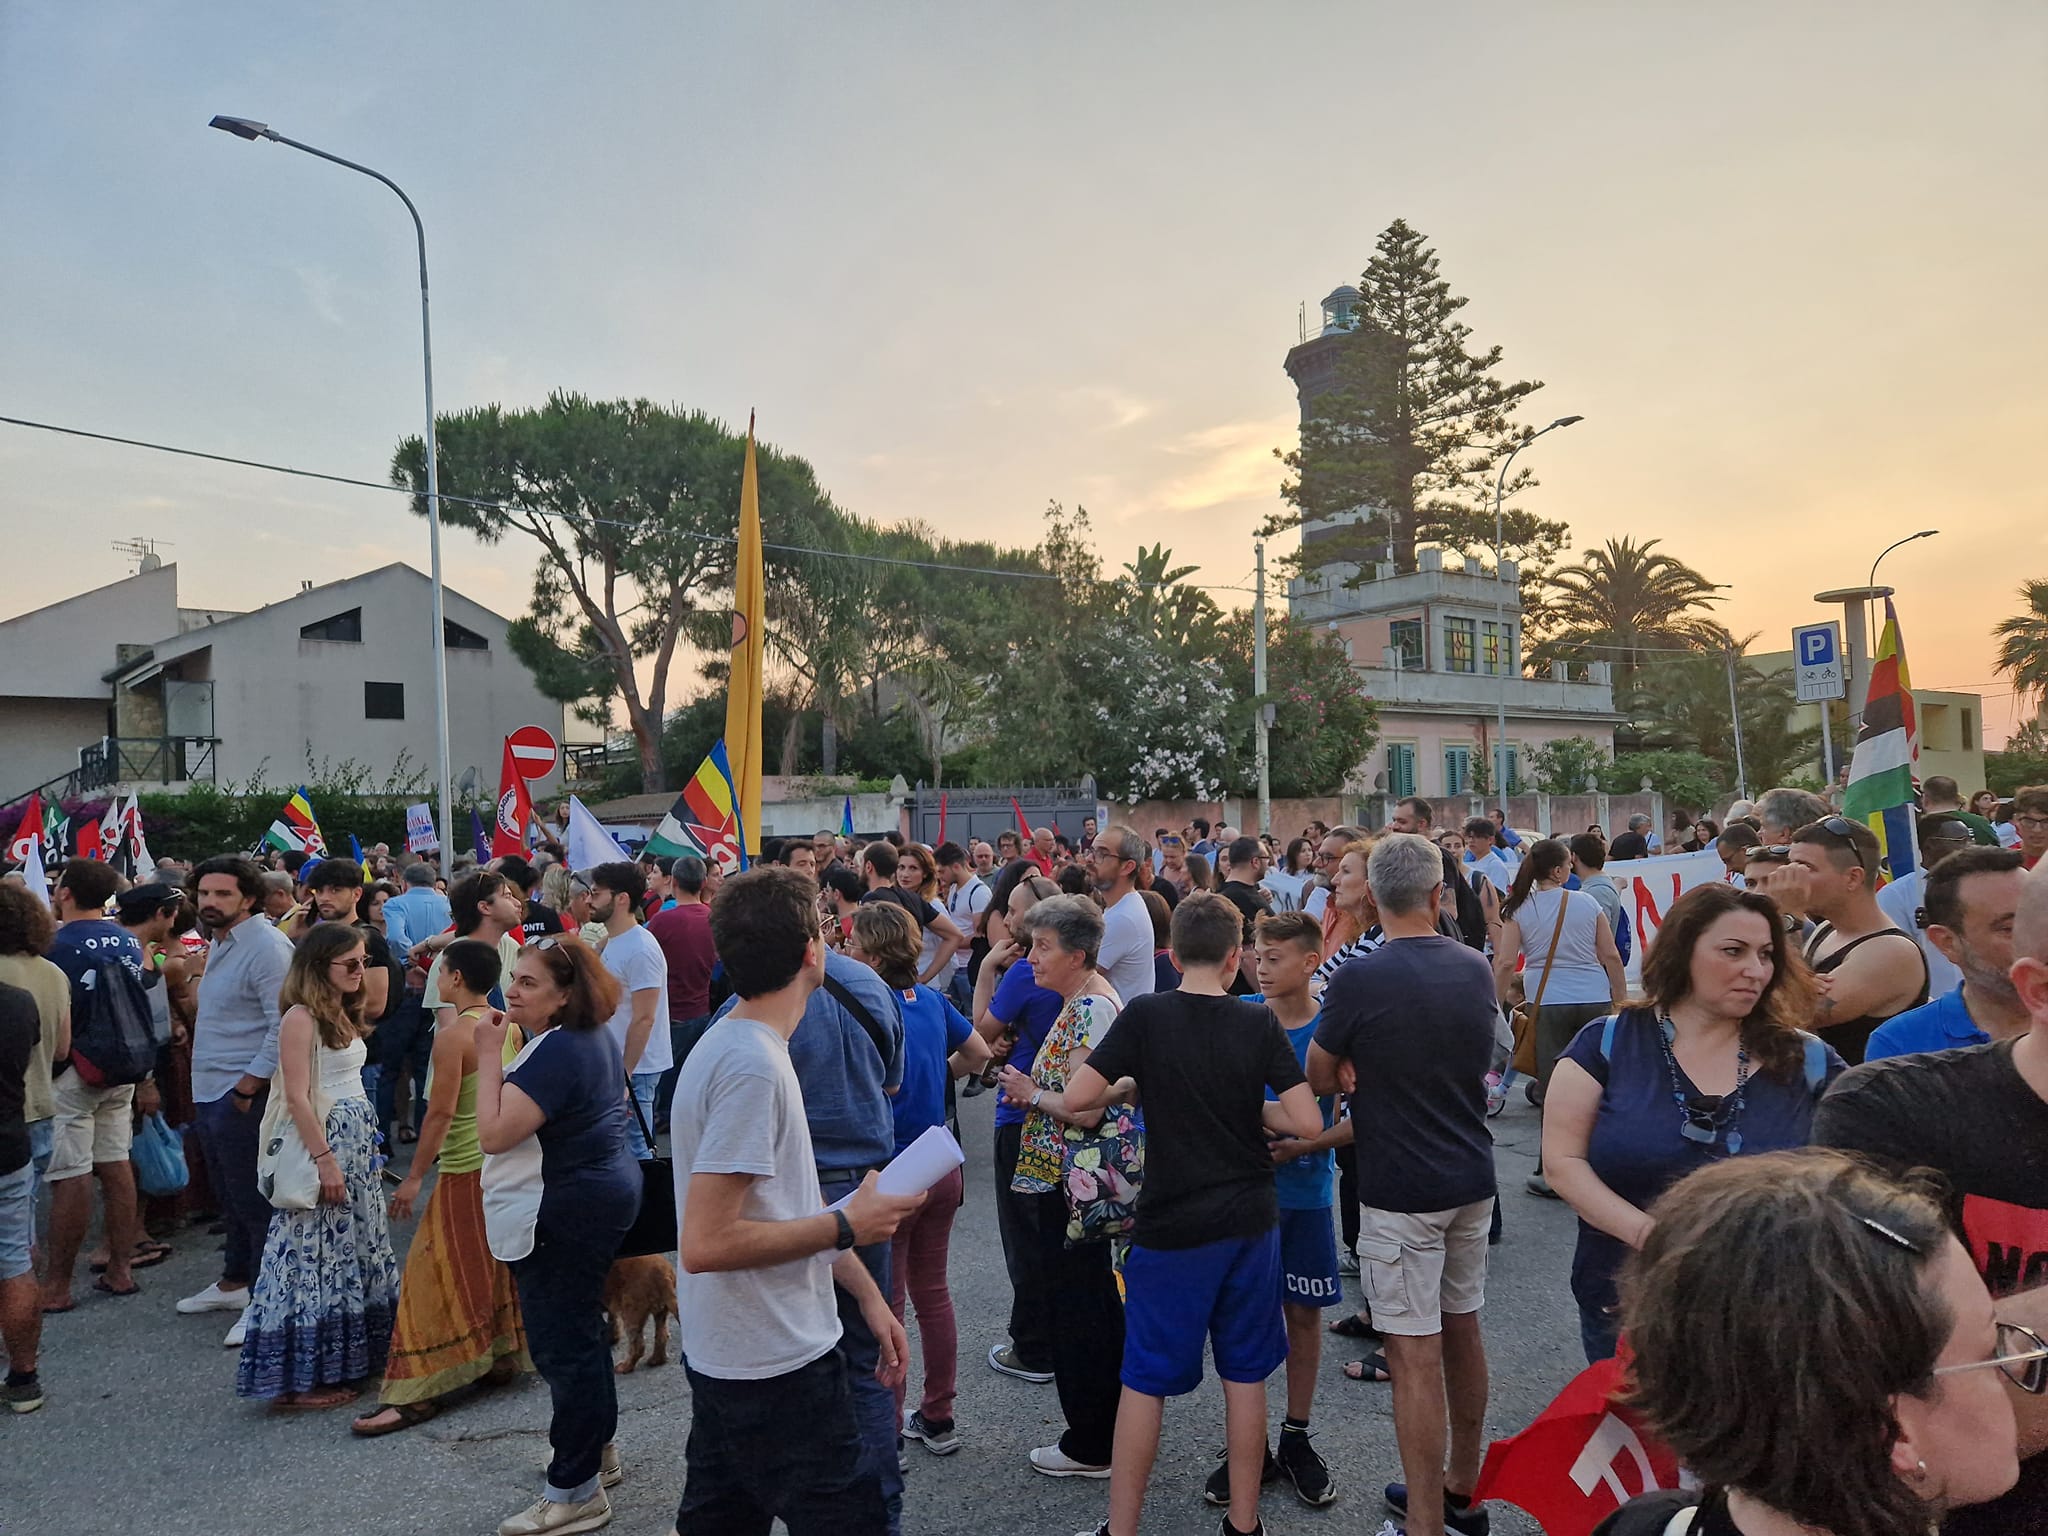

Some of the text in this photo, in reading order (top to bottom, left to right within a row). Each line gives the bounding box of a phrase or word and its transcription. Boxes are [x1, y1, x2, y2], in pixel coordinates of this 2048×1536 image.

[1807, 634, 1826, 662] P
[522, 922, 546, 932] ONTE
[101, 936, 141, 949] POTE
[1286, 1273, 1337, 1297] COOL
